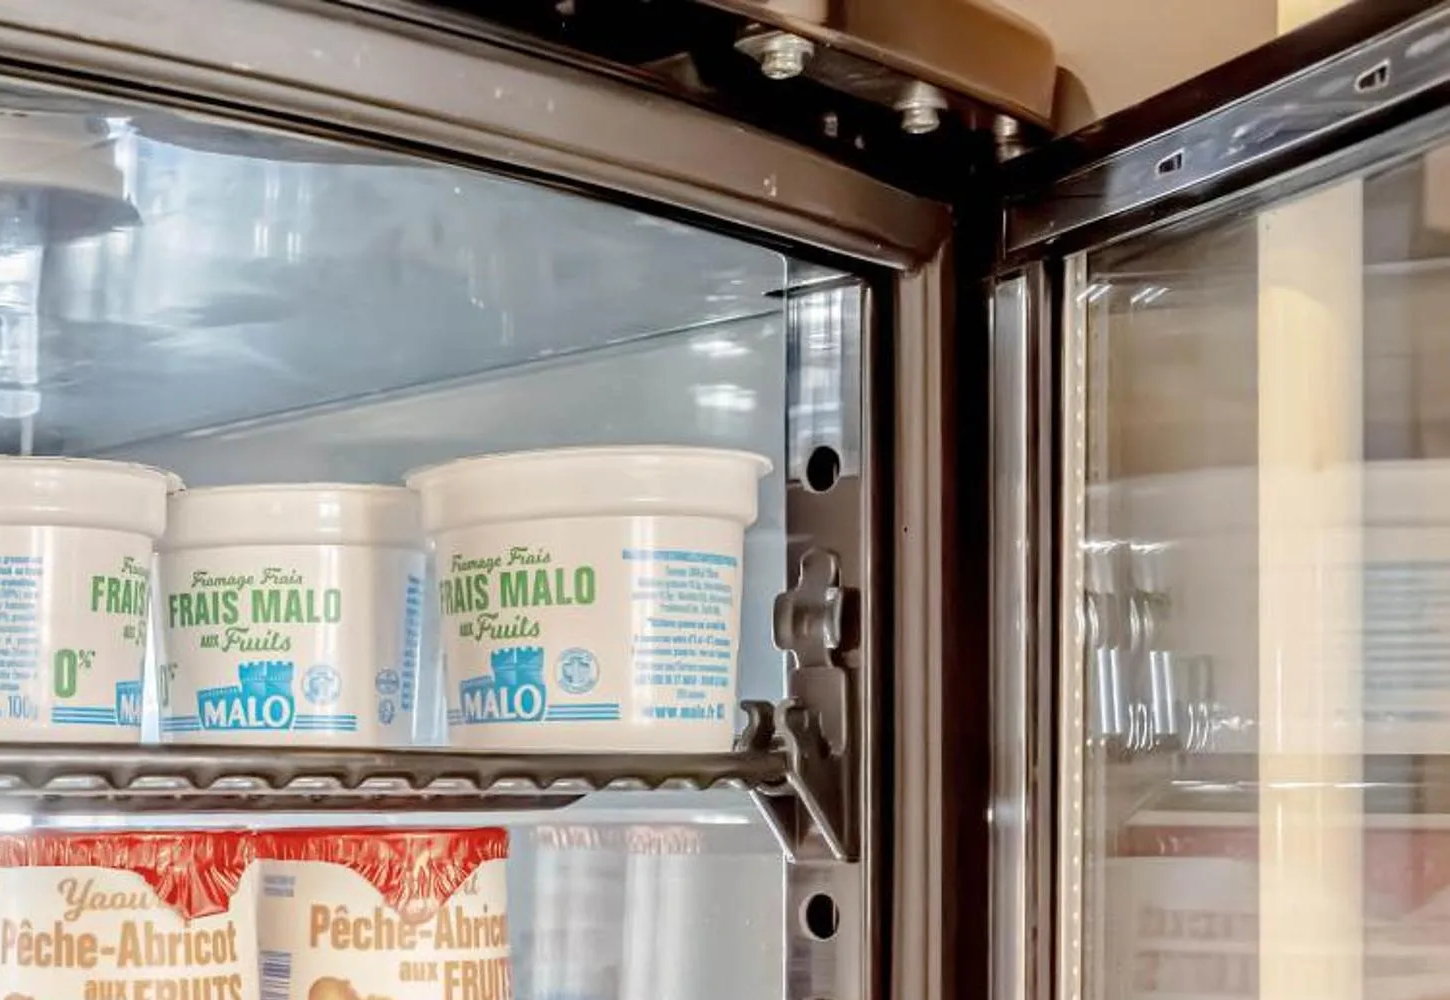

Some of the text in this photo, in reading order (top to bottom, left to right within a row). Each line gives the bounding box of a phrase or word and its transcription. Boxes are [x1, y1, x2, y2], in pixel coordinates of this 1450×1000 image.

[506, 546, 552, 567] Frais
[190, 567, 303, 590] Fromage Frais
[500, 565, 597, 609] MALO
[169, 588, 342, 629] FRAIS MALO
[222, 625, 292, 653] Fruits
[474, 612, 541, 643] Fruits
[202, 694, 291, 730] MALO
[462, 683, 543, 722] MALO
[1, 919, 238, 969] Pêche-Abricot
[399, 961, 439, 982] aux
